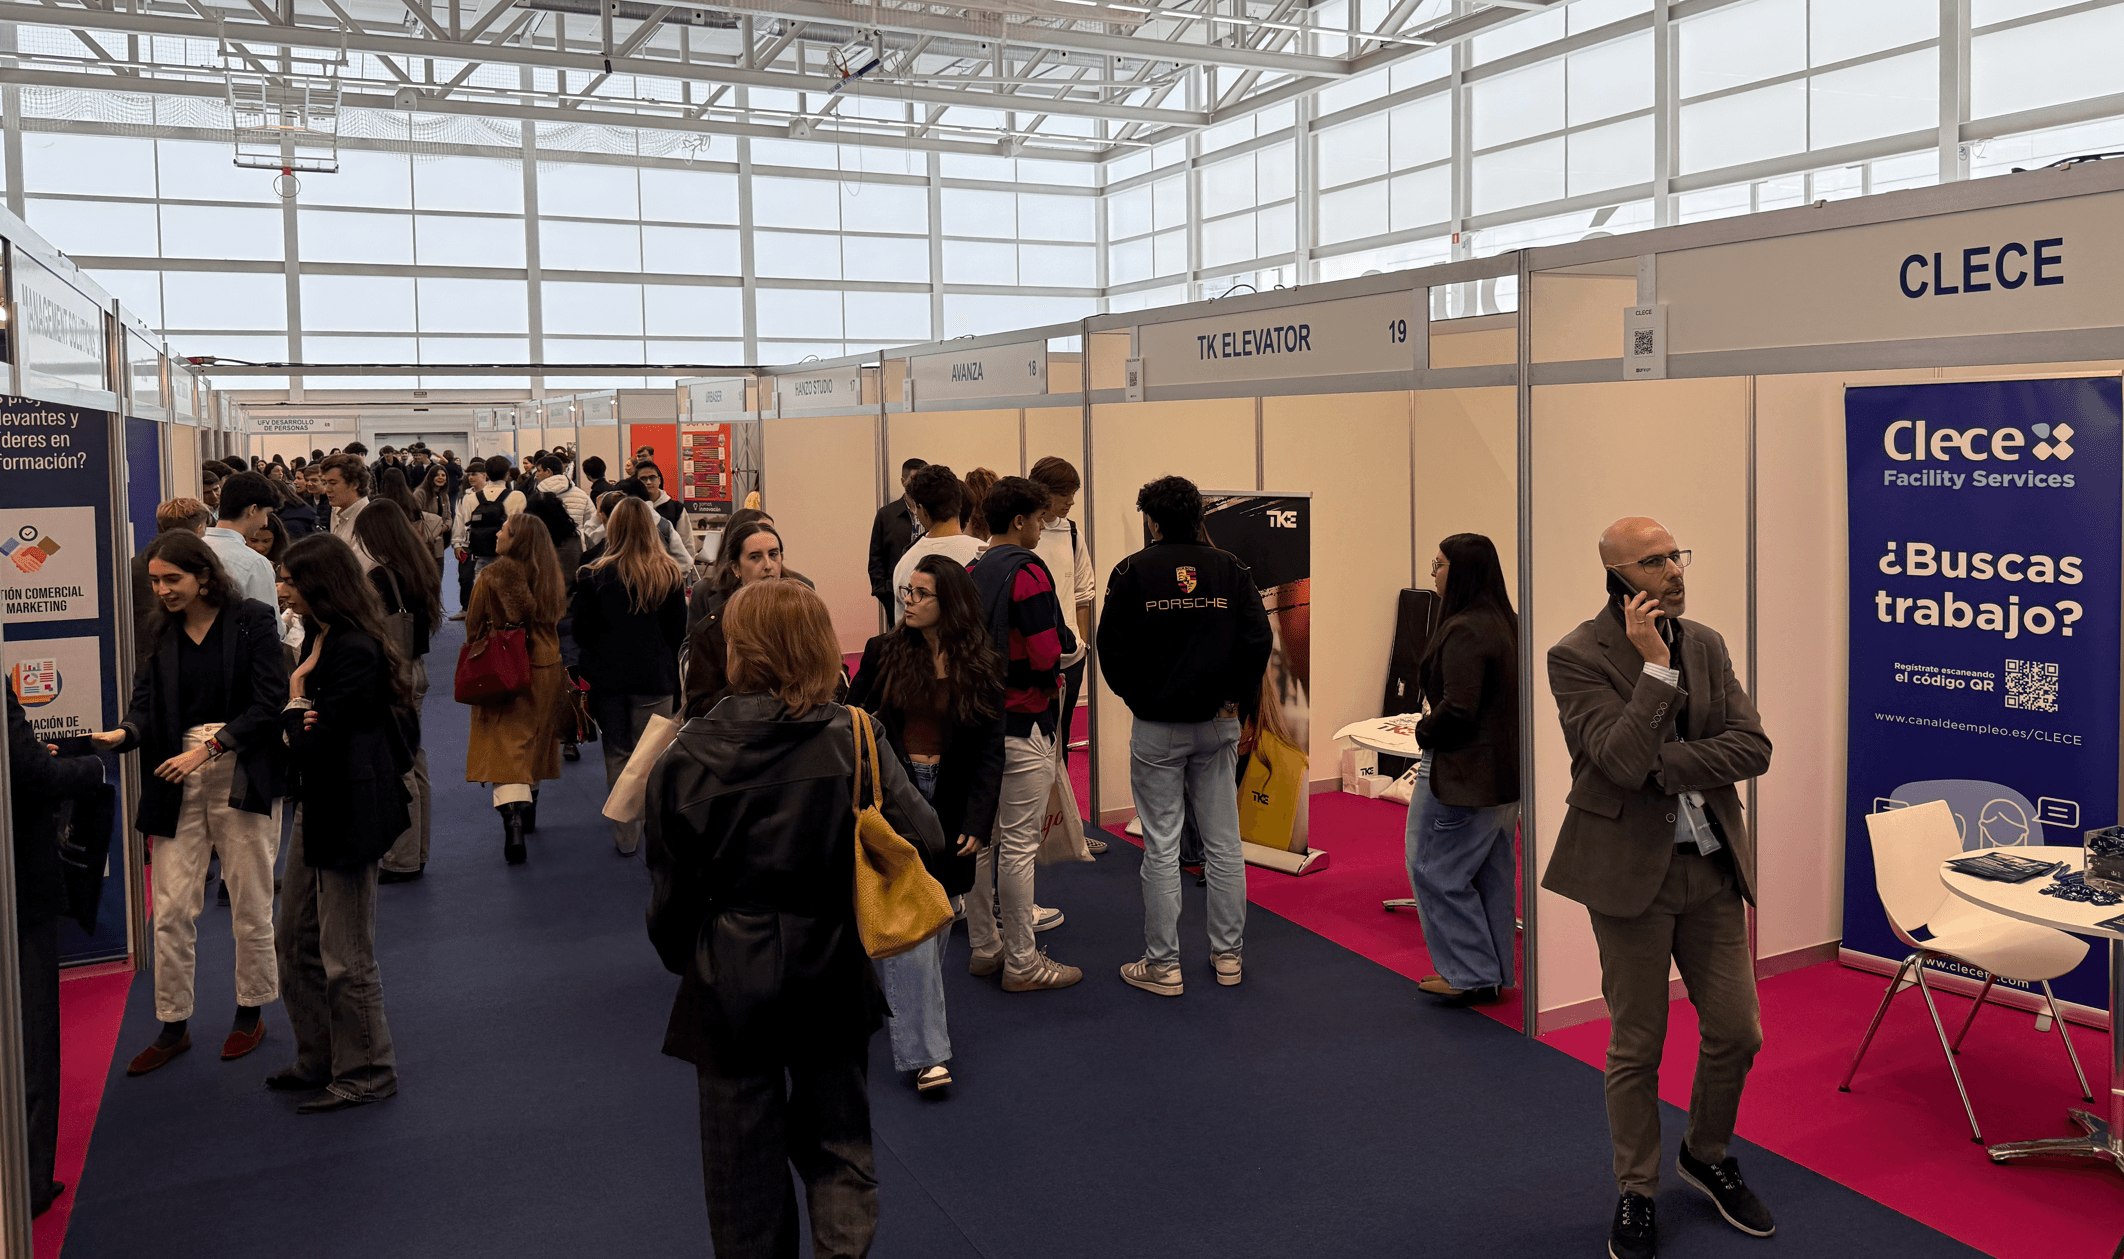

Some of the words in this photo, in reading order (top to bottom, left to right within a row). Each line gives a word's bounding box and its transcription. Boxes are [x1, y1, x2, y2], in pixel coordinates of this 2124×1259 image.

[1898, 237, 2065, 299] CLECE
[1388, 319, 1407, 343] 19
[1197, 334, 1218, 360] TK
[1222, 323, 1312, 358] ELEVATOR
[951, 361, 984, 382] AVANZA
[1028, 360, 1037, 377] 18
[813, 379, 833, 395] STUDIO
[70, 412, 79, 429] y
[0, 431, 47, 448] deres
[51, 434, 70, 447] en
[1883, 420, 2026, 461] Clece
[1883, 469, 1966, 490] Facility
[1972, 470, 2075, 488] Services
[1266, 510, 1298, 529] TKE
[1878, 541, 2084, 585] ¿Buscas
[25, 586, 85, 600] COMERCIAL
[6, 600, 67, 614] MARKETING
[1145, 597, 1228, 612] PORSCHE
[1875, 590, 2084, 639] trabajo?
[1894, 662, 1939, 674] Regístrate
[1941, 667, 1995, 679] escaneando
[1894, 671, 1908, 683] el
[1912, 673, 1966, 690] código
[1969, 678, 1995, 692] QR
[66, 715, 79, 728] DE
[1875, 712, 2082, 746] www.canaldeempleo.es/CLECE
[1360, 766, 1374, 777] TKE
[1251, 790, 1269, 806] TKE
